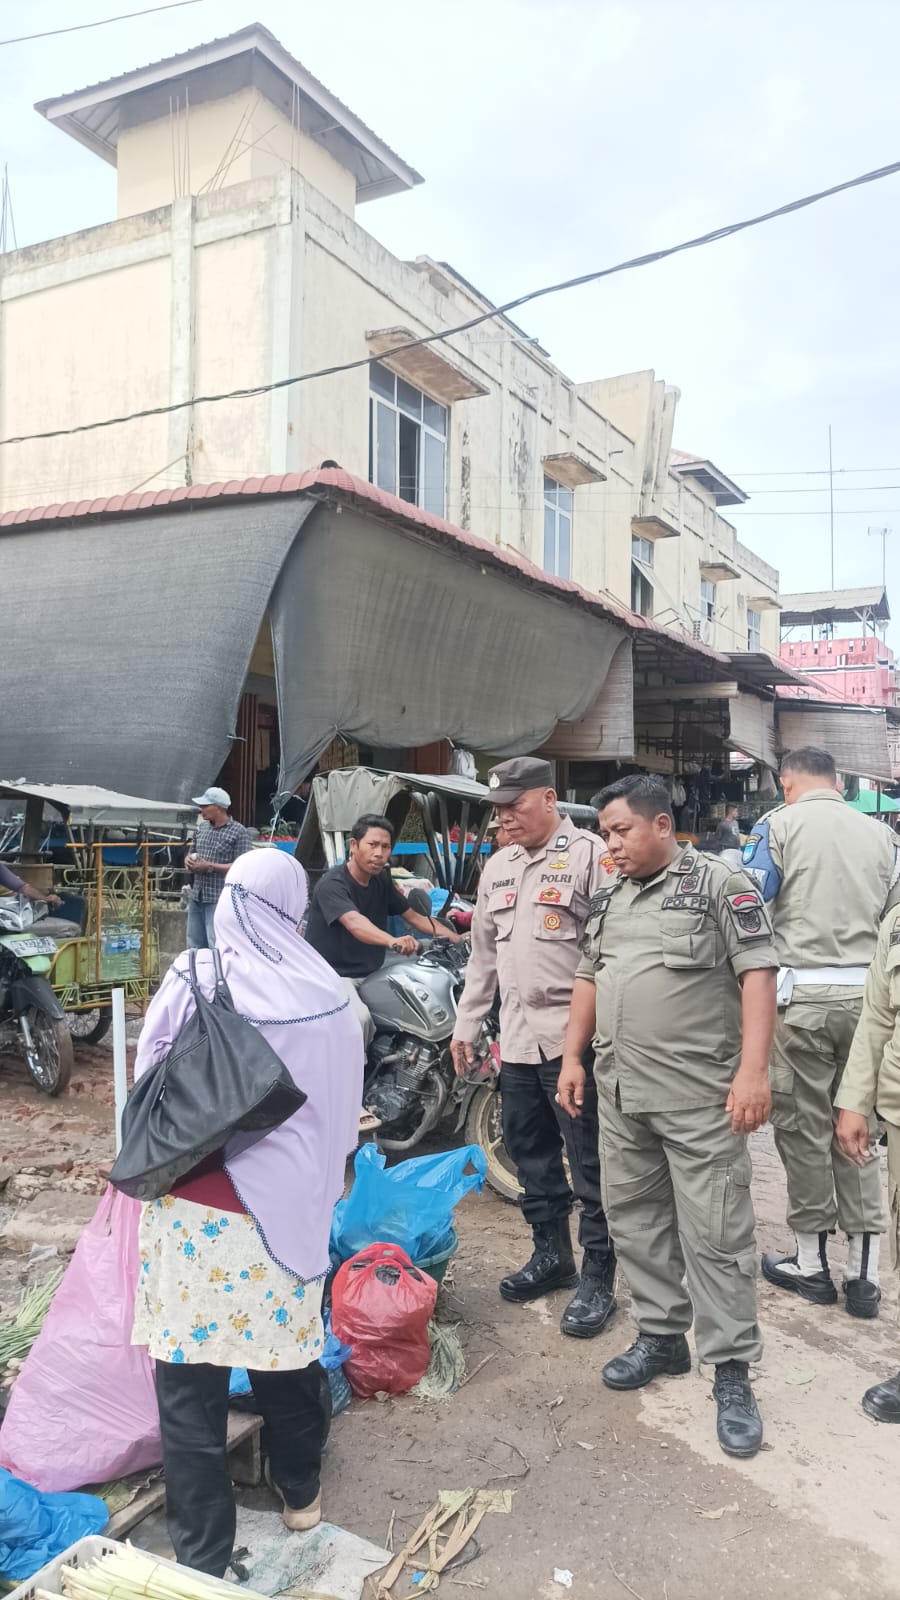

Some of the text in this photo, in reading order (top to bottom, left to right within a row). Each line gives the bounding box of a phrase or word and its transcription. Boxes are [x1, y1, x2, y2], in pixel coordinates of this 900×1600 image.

[540, 873, 572, 883] POLRI
[665, 897, 707, 908] POL PP
